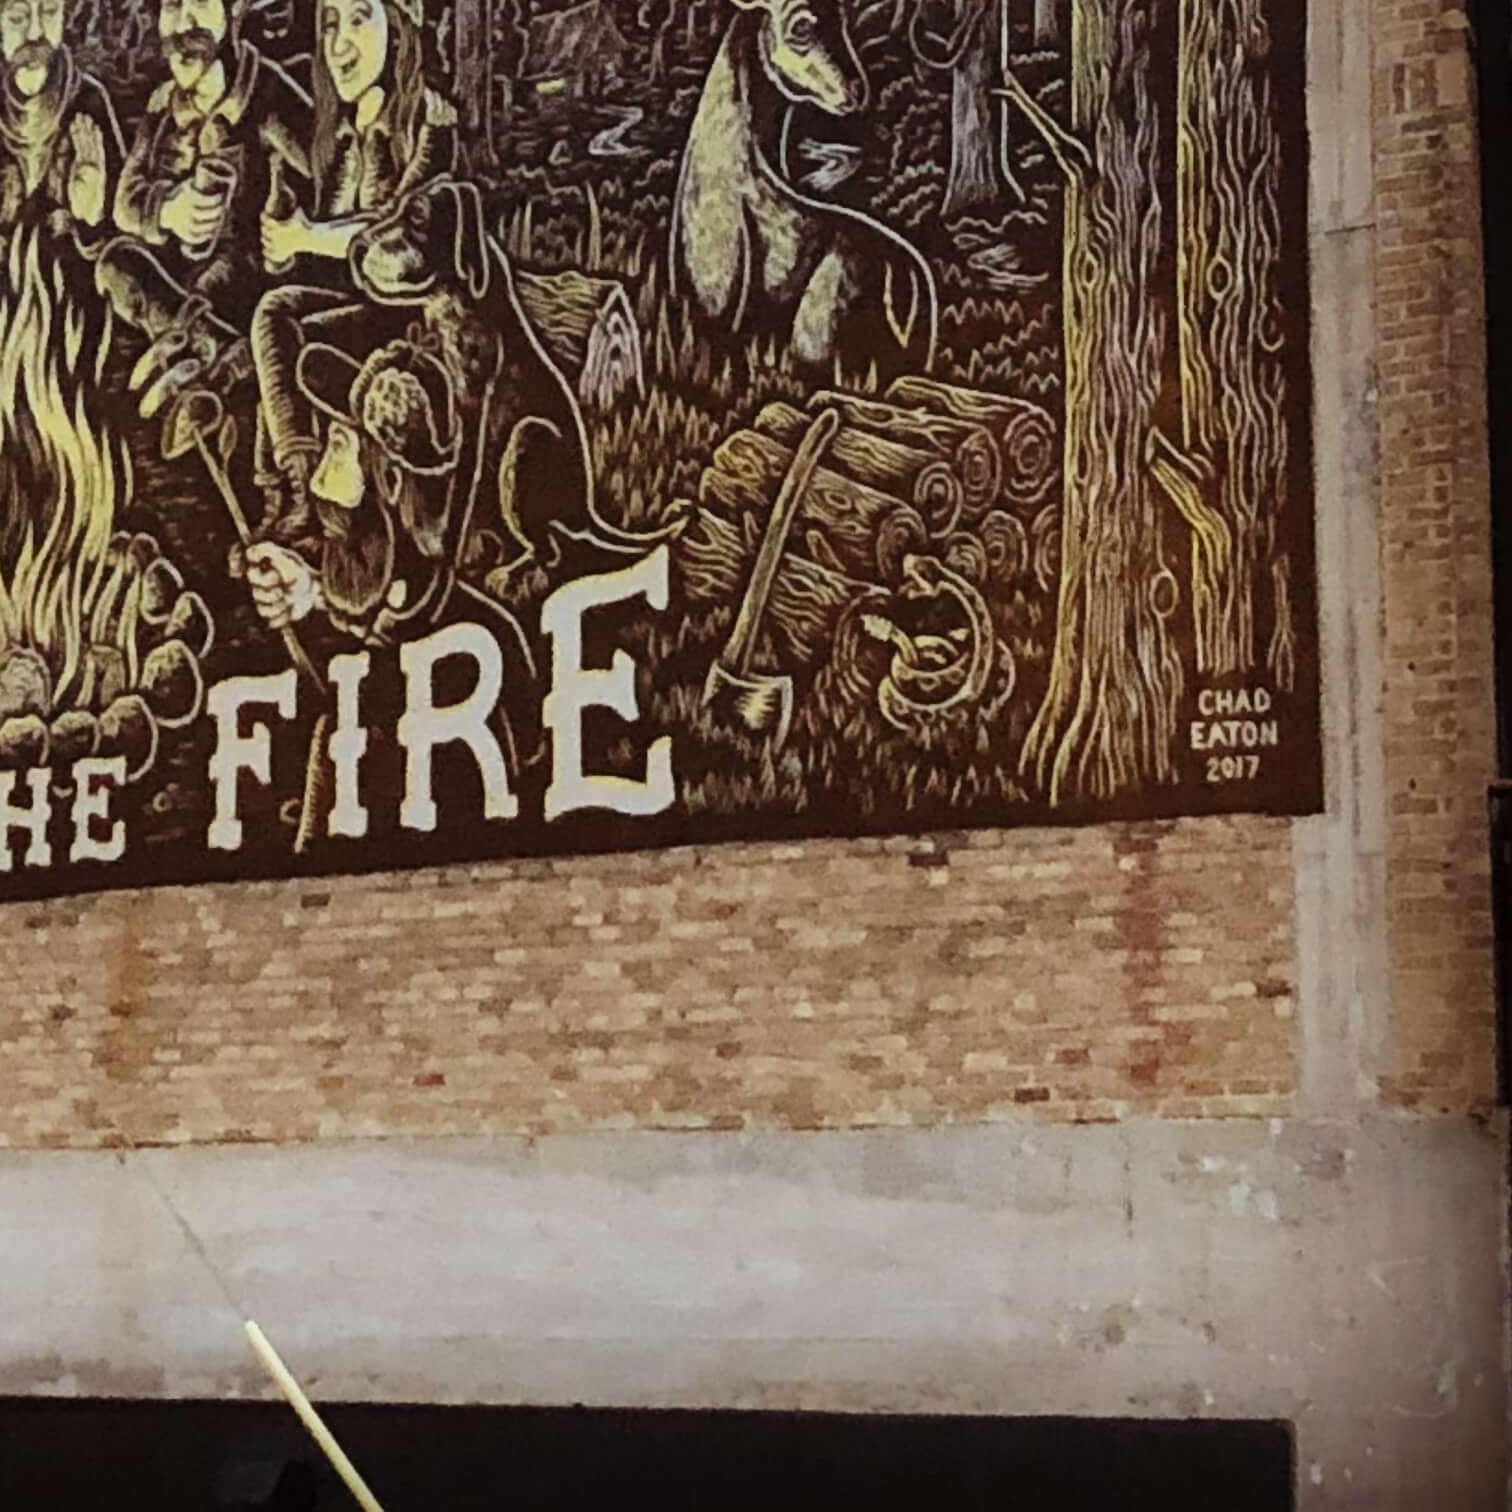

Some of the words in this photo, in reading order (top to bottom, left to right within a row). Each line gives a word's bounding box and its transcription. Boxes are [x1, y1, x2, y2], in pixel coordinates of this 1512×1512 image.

[207, 543, 676, 851] FIRE
[1198, 687, 1271, 716] CHAD
[1190, 720, 1278, 749] EATON
[1206, 754, 1260, 782] 2017
